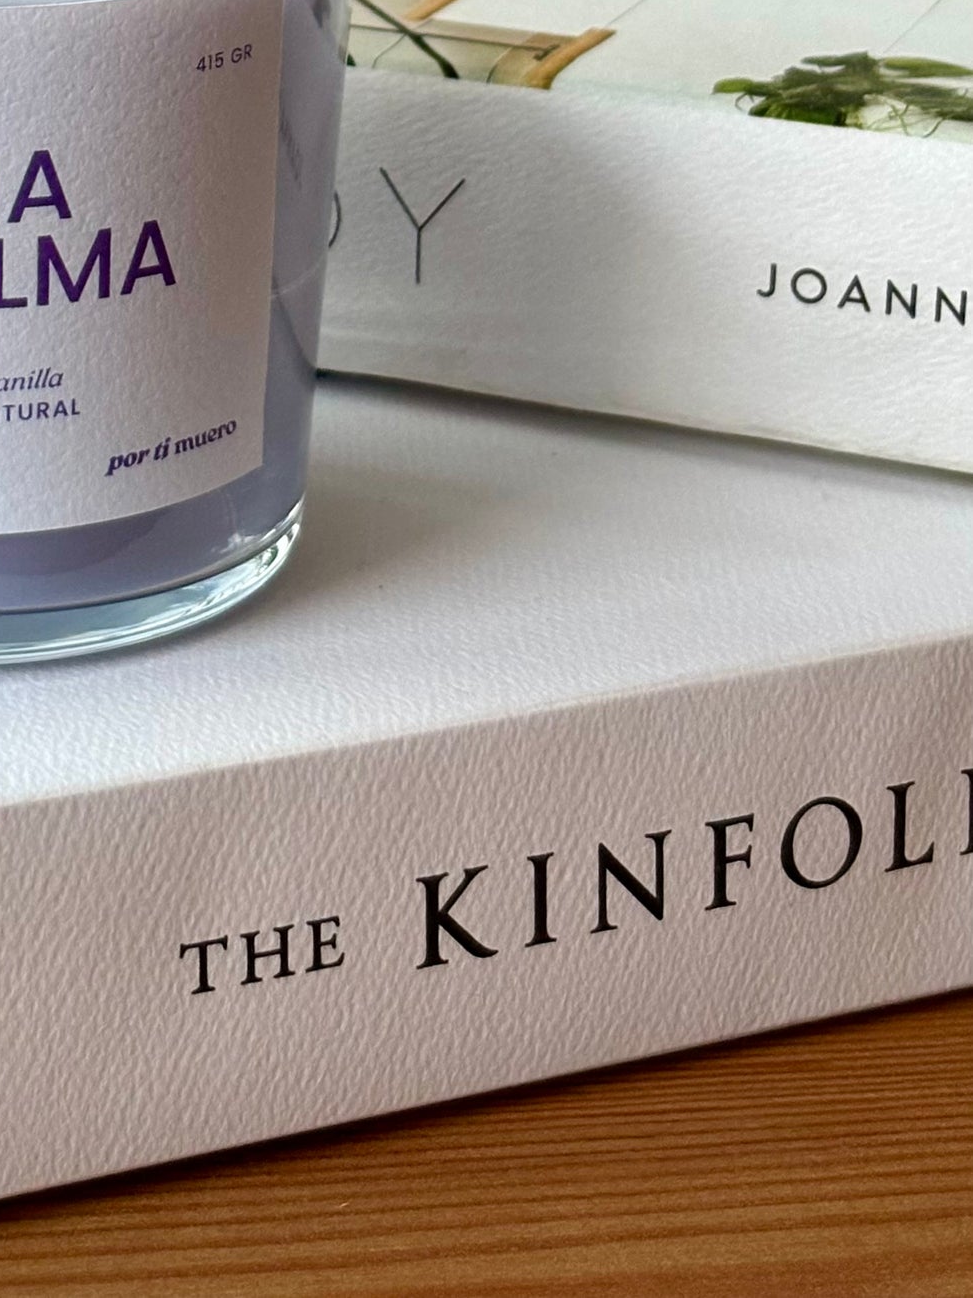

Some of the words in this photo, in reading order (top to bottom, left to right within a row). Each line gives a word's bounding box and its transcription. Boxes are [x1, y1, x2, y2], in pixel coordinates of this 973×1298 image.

[196, 51, 224, 72] 415
[230, 43, 253, 64] GR
[756, 263, 968, 326] JOANN
[105, 449, 150, 476] por
[153, 437, 171, 461] ti
[174, 419, 237, 455] muero
[179, 915, 345, 995] THE
[415, 768, 973, 971] KINFOL
